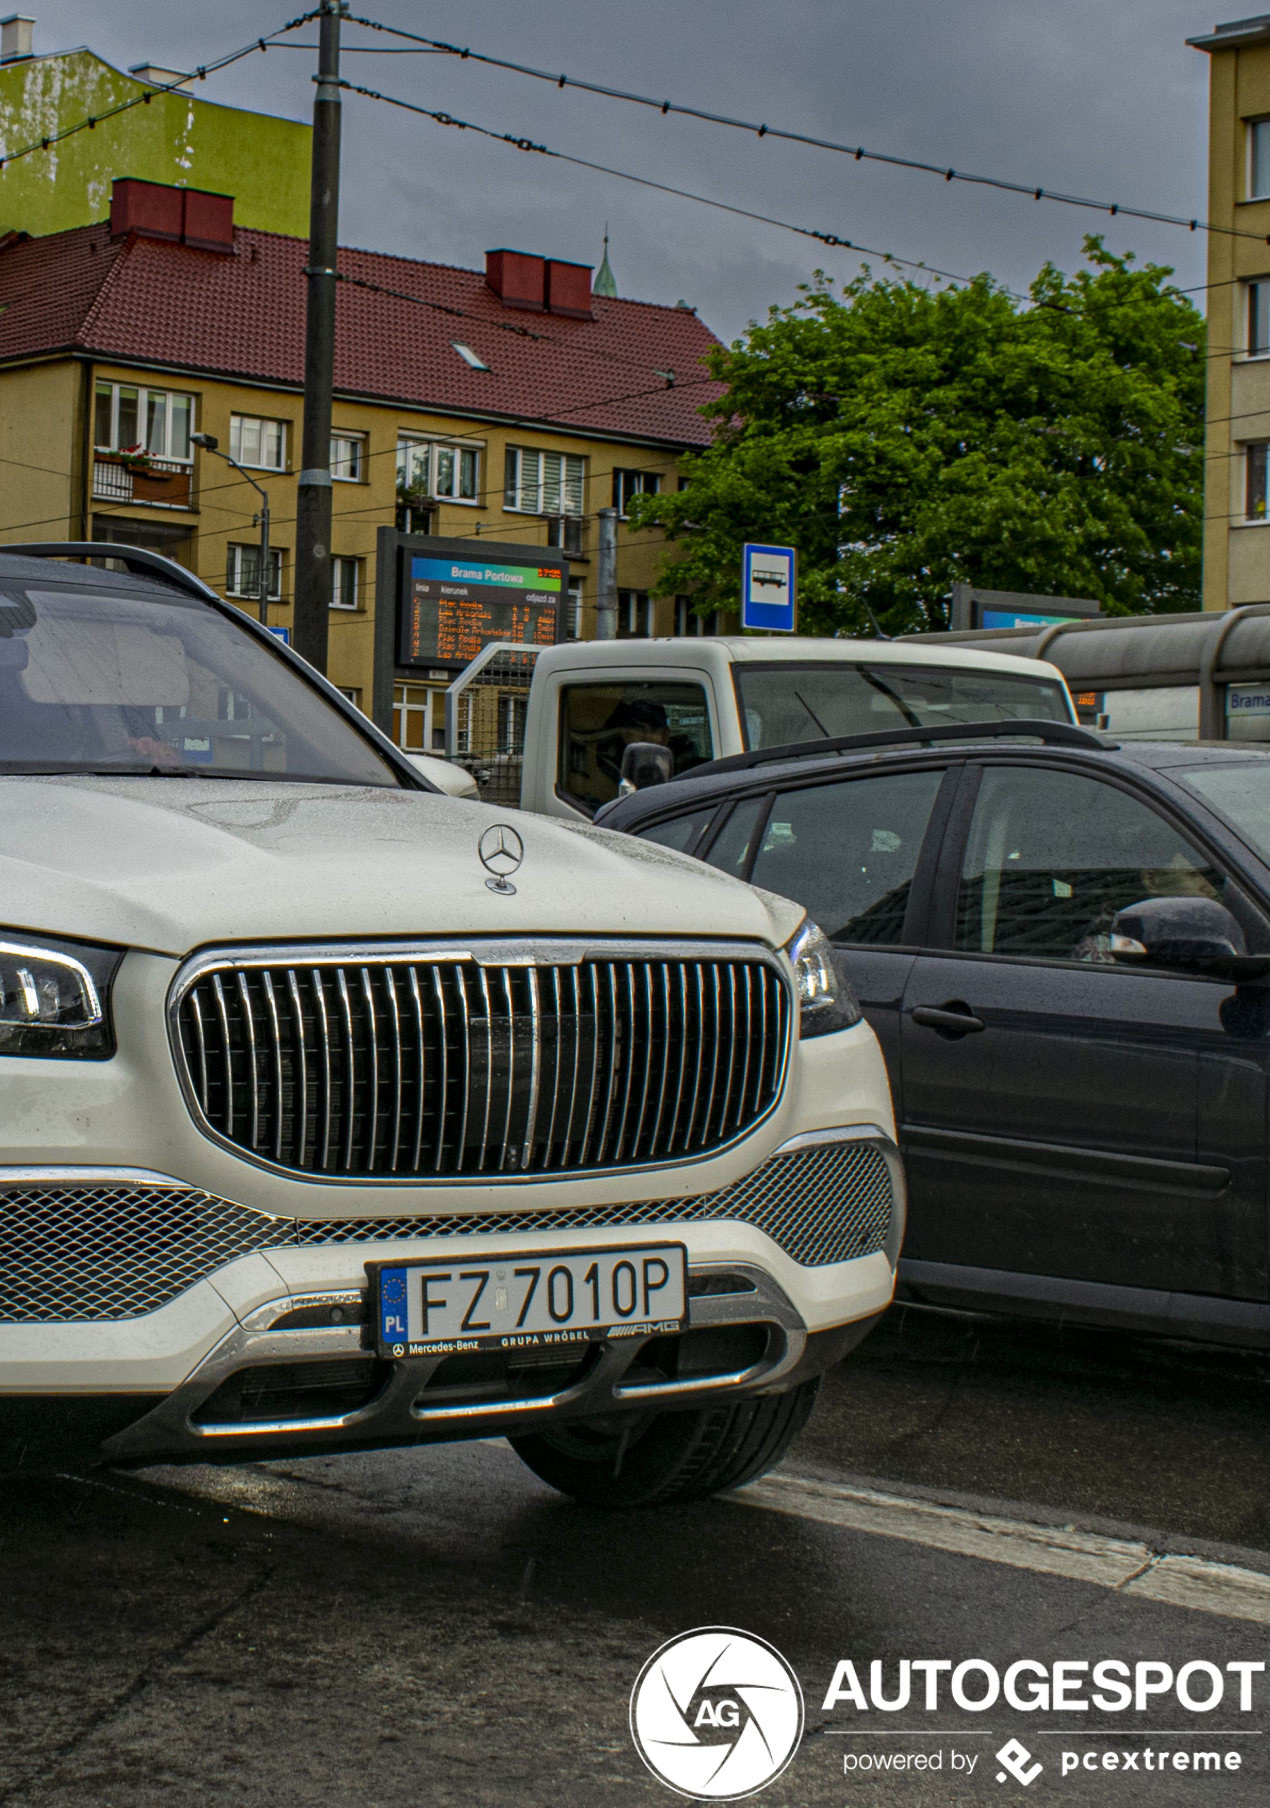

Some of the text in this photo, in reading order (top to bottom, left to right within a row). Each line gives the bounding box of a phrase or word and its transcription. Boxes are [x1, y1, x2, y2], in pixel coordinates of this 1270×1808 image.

[451, 566, 524, 584] Brama Portowa
[415, 583, 469, 595] linia kierunek
[525, 593, 556, 604] odjazd za
[421, 1257, 669, 1335] FZ 7010P
[385, 1315, 405, 1333] PL
[632, 1320, 680, 1335] AMG
[501, 1329, 590, 1347] GRUPA WRÓBEL
[409, 1339, 480, 1355] Mercedes-Benz
